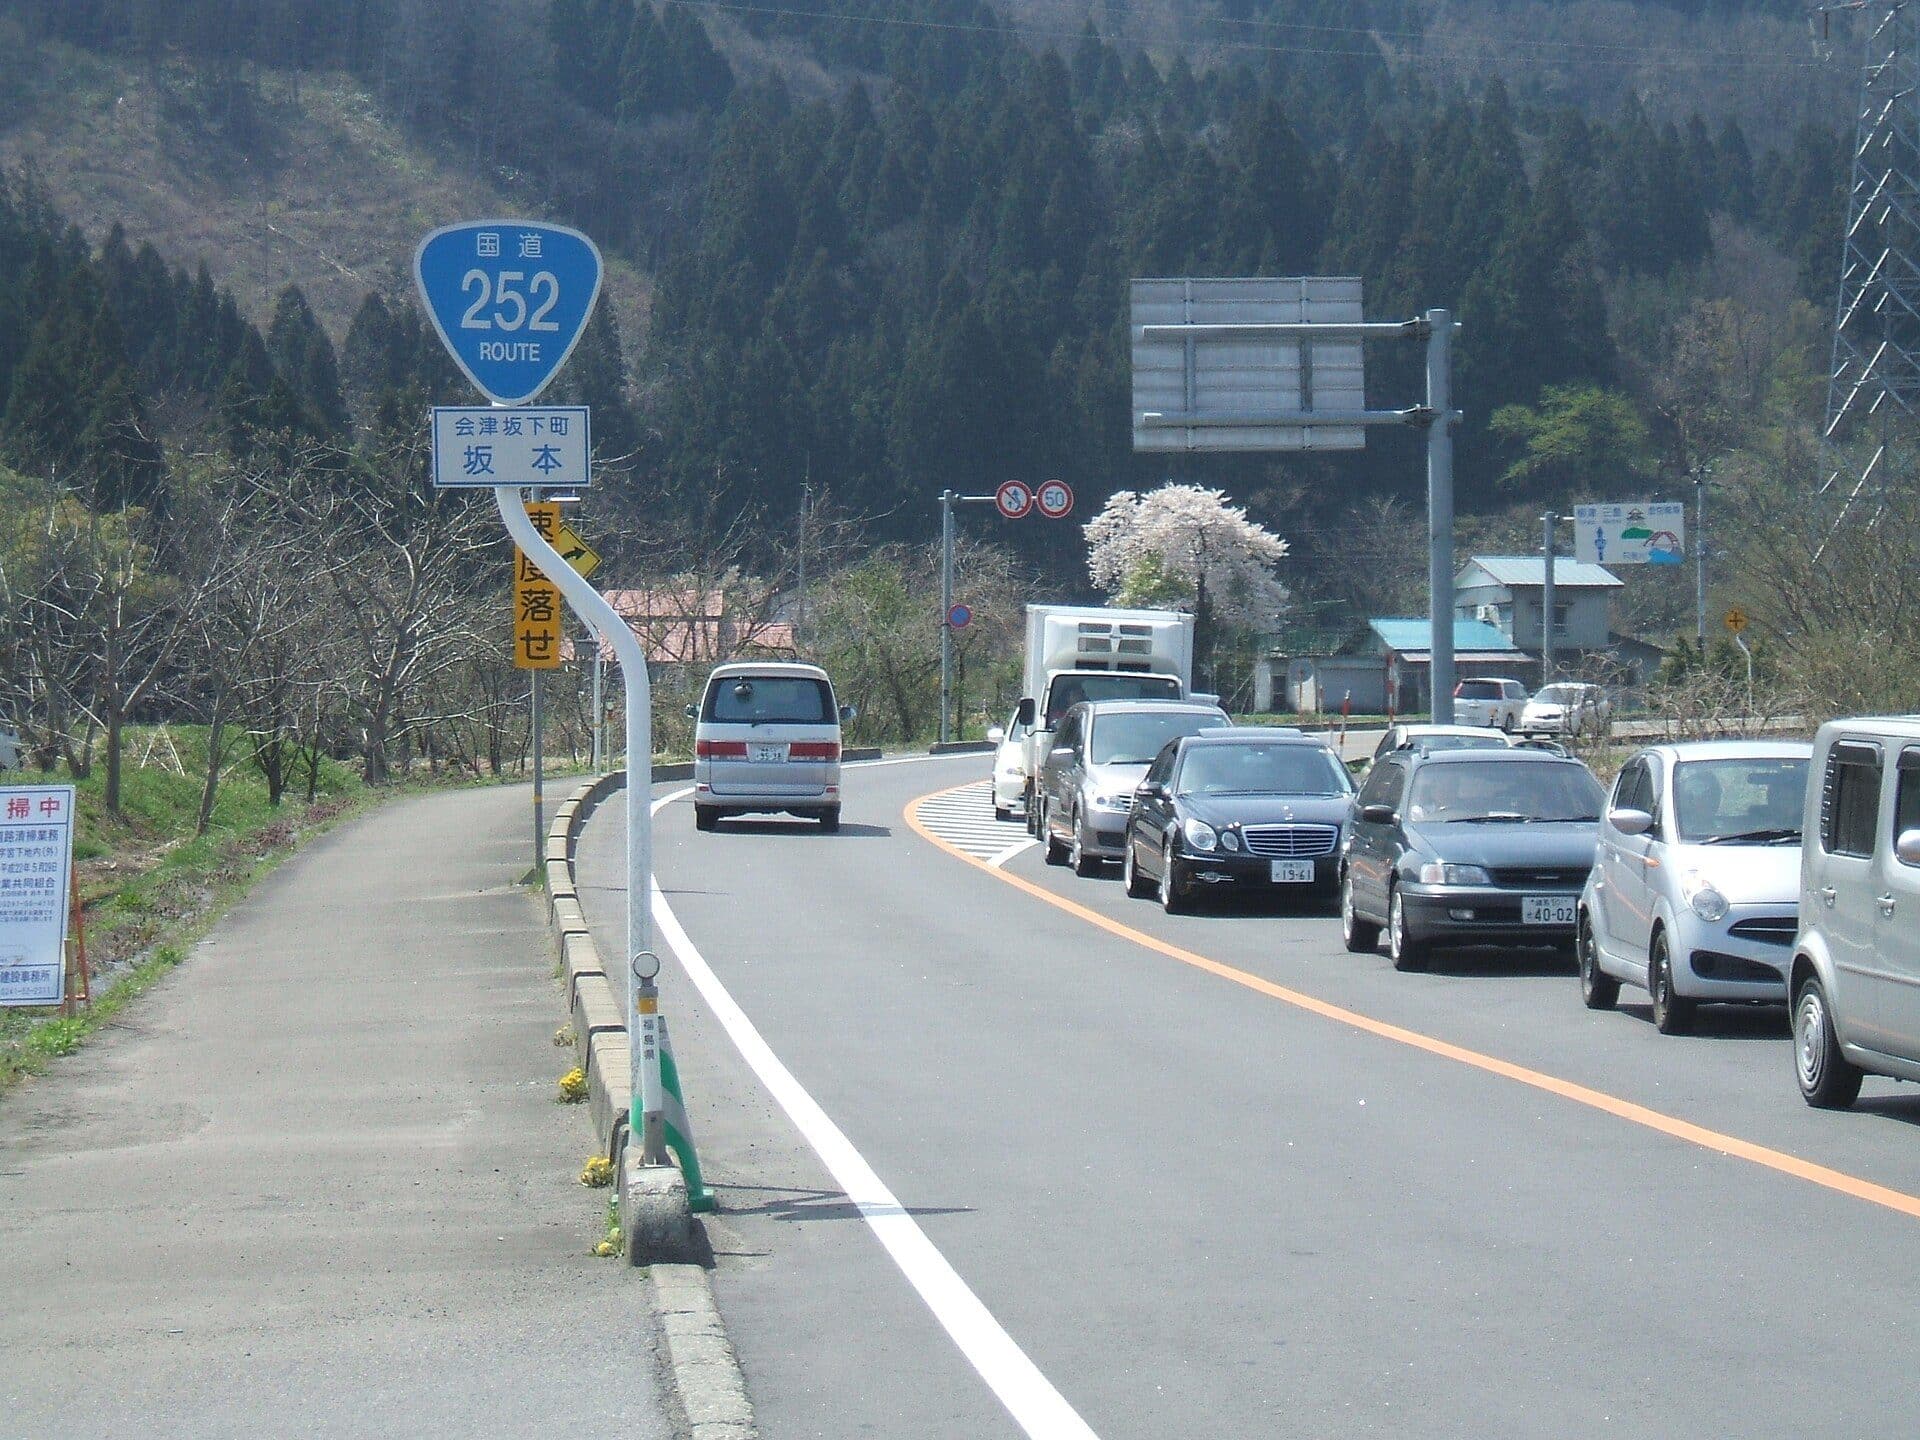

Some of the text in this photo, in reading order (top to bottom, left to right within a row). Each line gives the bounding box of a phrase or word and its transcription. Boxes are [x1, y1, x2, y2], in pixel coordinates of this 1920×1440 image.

[476, 232, 543, 258] 国道
[460, 268, 560, 332] 252
[479, 341, 541, 362] ROUTE
[455, 416, 570, 437] 会津坂下町
[463, 443, 563, 476] 坂本
[1045, 490, 1065, 507] 50
[7, 797, 61, 819] 掃中
[1534, 907, 1573, 921] 40-02
